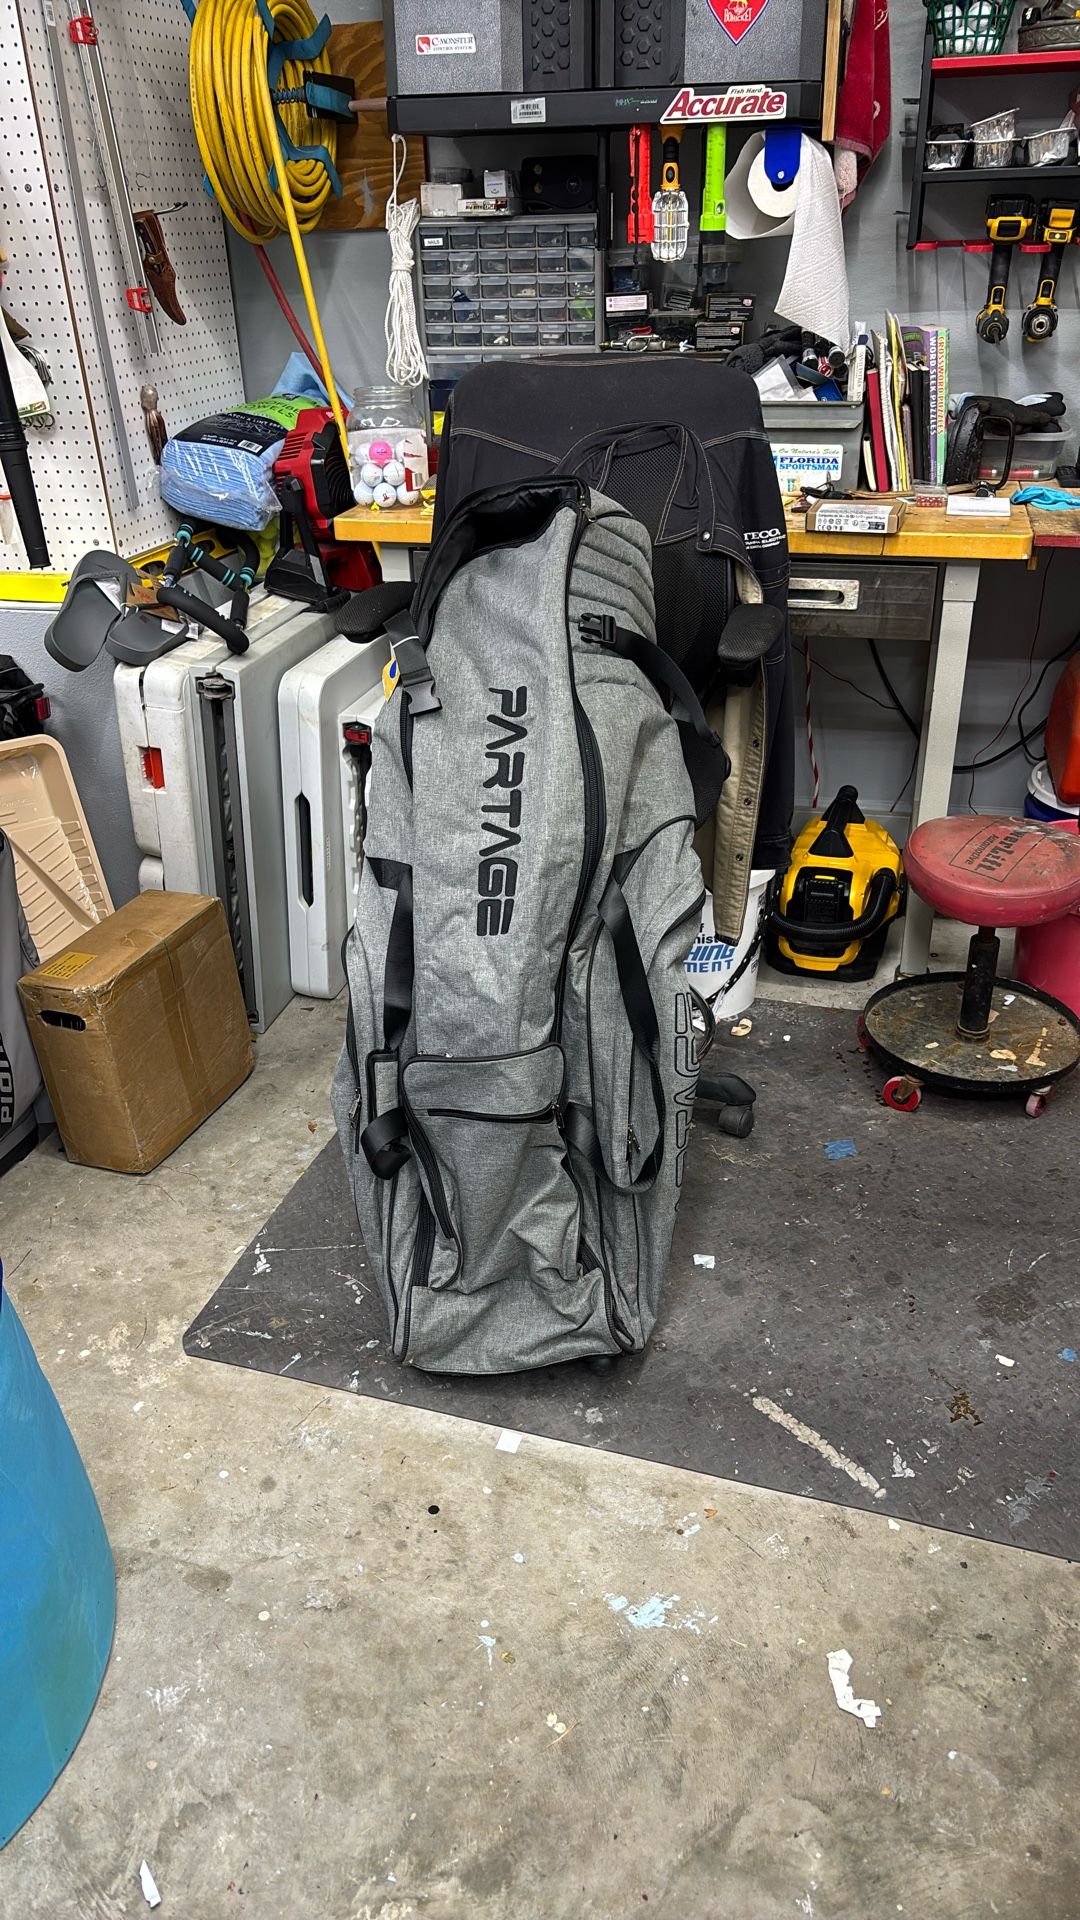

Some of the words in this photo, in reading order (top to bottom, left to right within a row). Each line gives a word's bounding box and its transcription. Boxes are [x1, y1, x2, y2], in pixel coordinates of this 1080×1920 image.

[666, 90, 785, 118] Accurate
[929, 336, 937, 366] WORD
[937, 336, 945, 393] CROSSWORD
[929, 395, 937, 436] PUZZLES
[779, 463, 839, 471] SPORTSMAN
[476, 685, 528, 937] PARTAGE
[964, 834, 999, 865] Automotive
